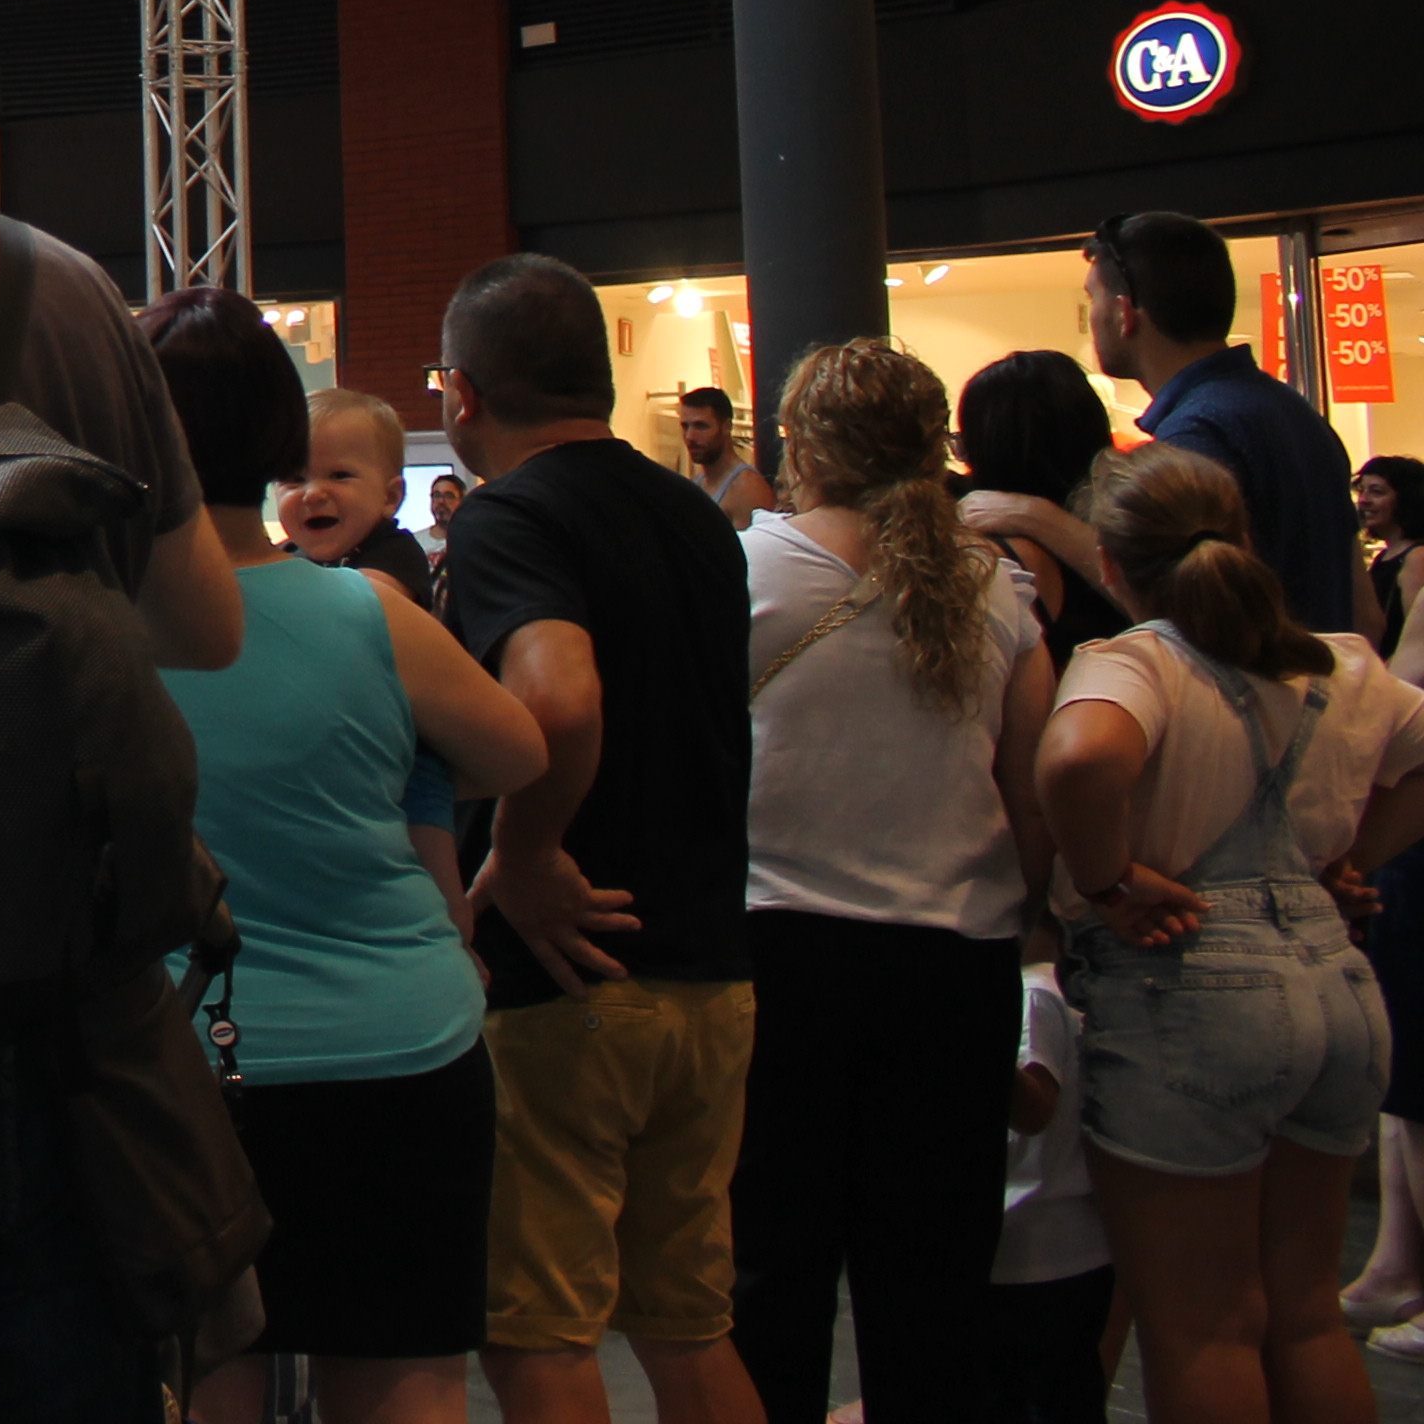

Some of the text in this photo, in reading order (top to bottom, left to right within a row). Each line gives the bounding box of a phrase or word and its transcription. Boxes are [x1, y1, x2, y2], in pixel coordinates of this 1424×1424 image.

[1126, 32, 1213, 92] C&A
[1325, 267, 1379, 292] -50%
[1328, 303, 1383, 328] -50%
[1331, 340, 1386, 365] -50%
